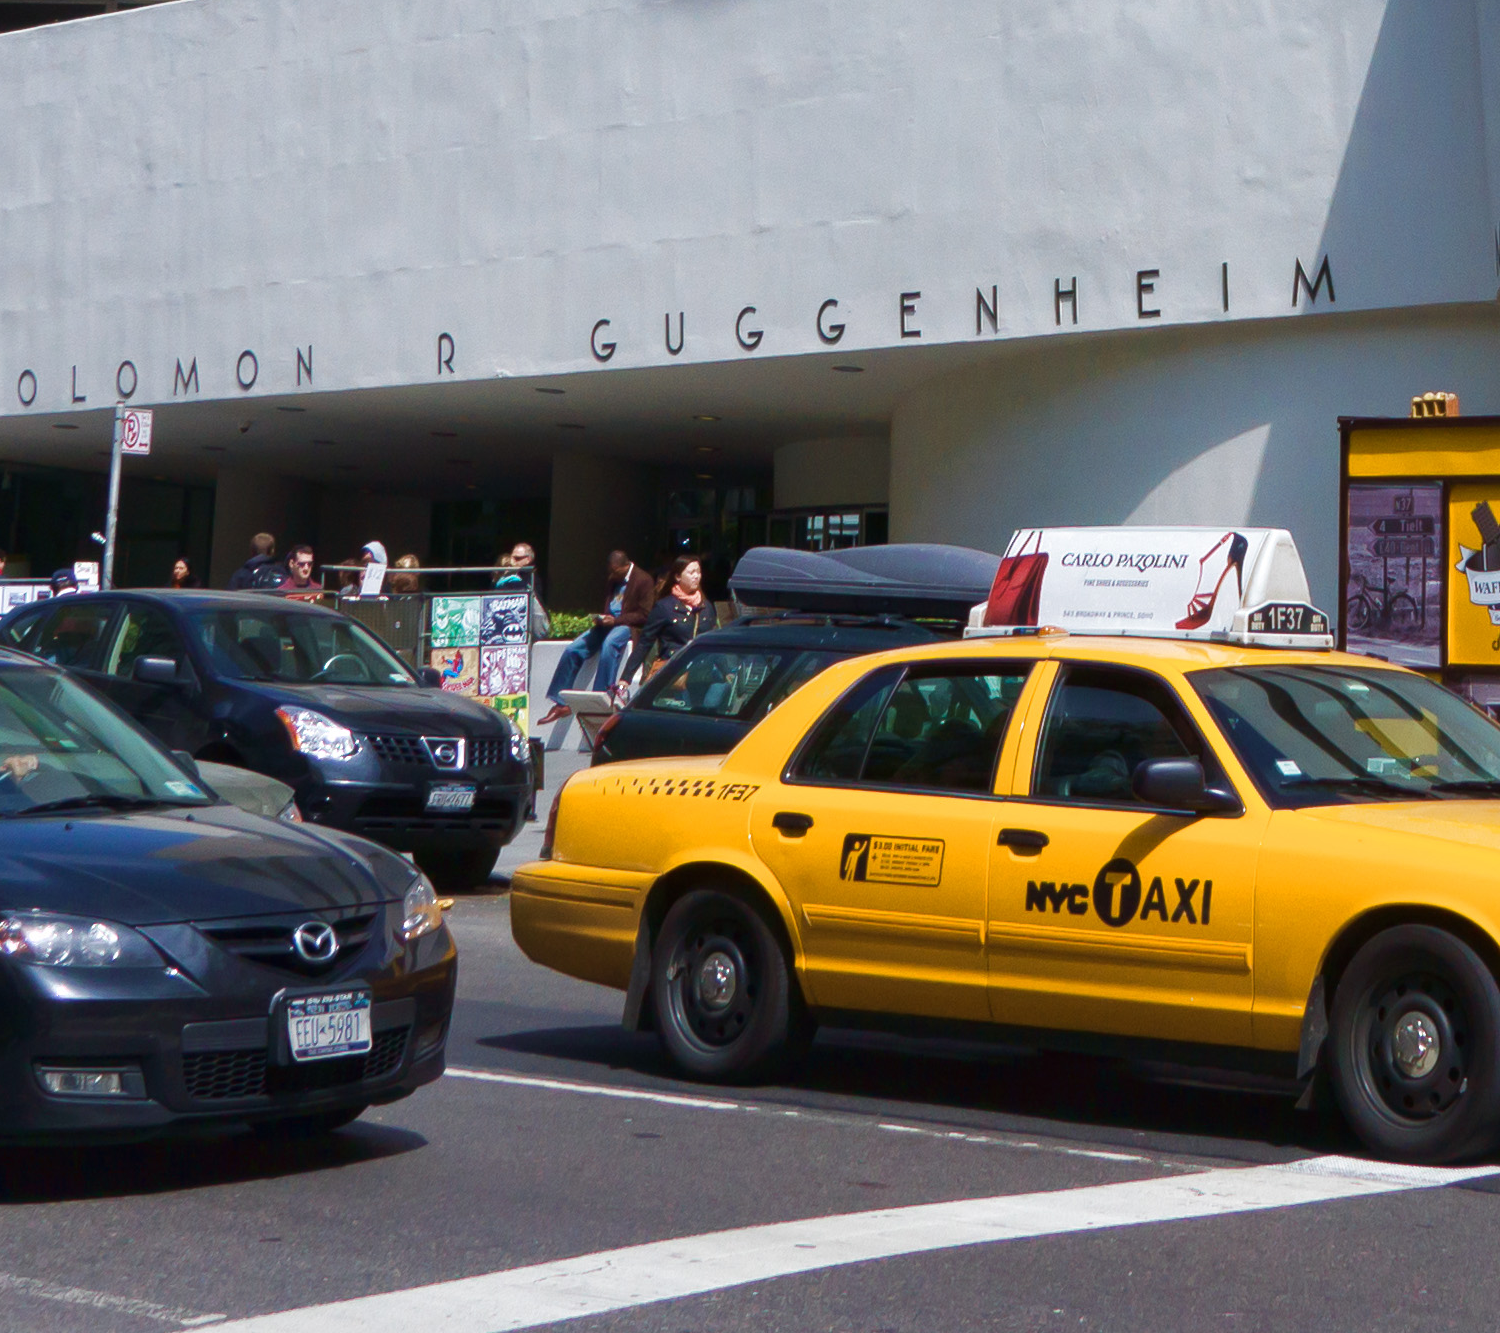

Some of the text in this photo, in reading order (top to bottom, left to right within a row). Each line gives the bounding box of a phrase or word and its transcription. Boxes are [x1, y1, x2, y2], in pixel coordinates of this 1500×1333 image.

[437, 331, 457, 376] R
[589, 253, 1337, 363] GUGGENHEIM
[1061, 552, 1190, 573] CARLO PAZOLINI
[491, 598, 526, 613] BATMAN
[1268, 606, 1304, 631] 1F37
[482, 648, 527, 670] SUPERMAN
[716, 783, 761, 803] 1F37
[1025, 871, 1213, 925] NYC TAXI
